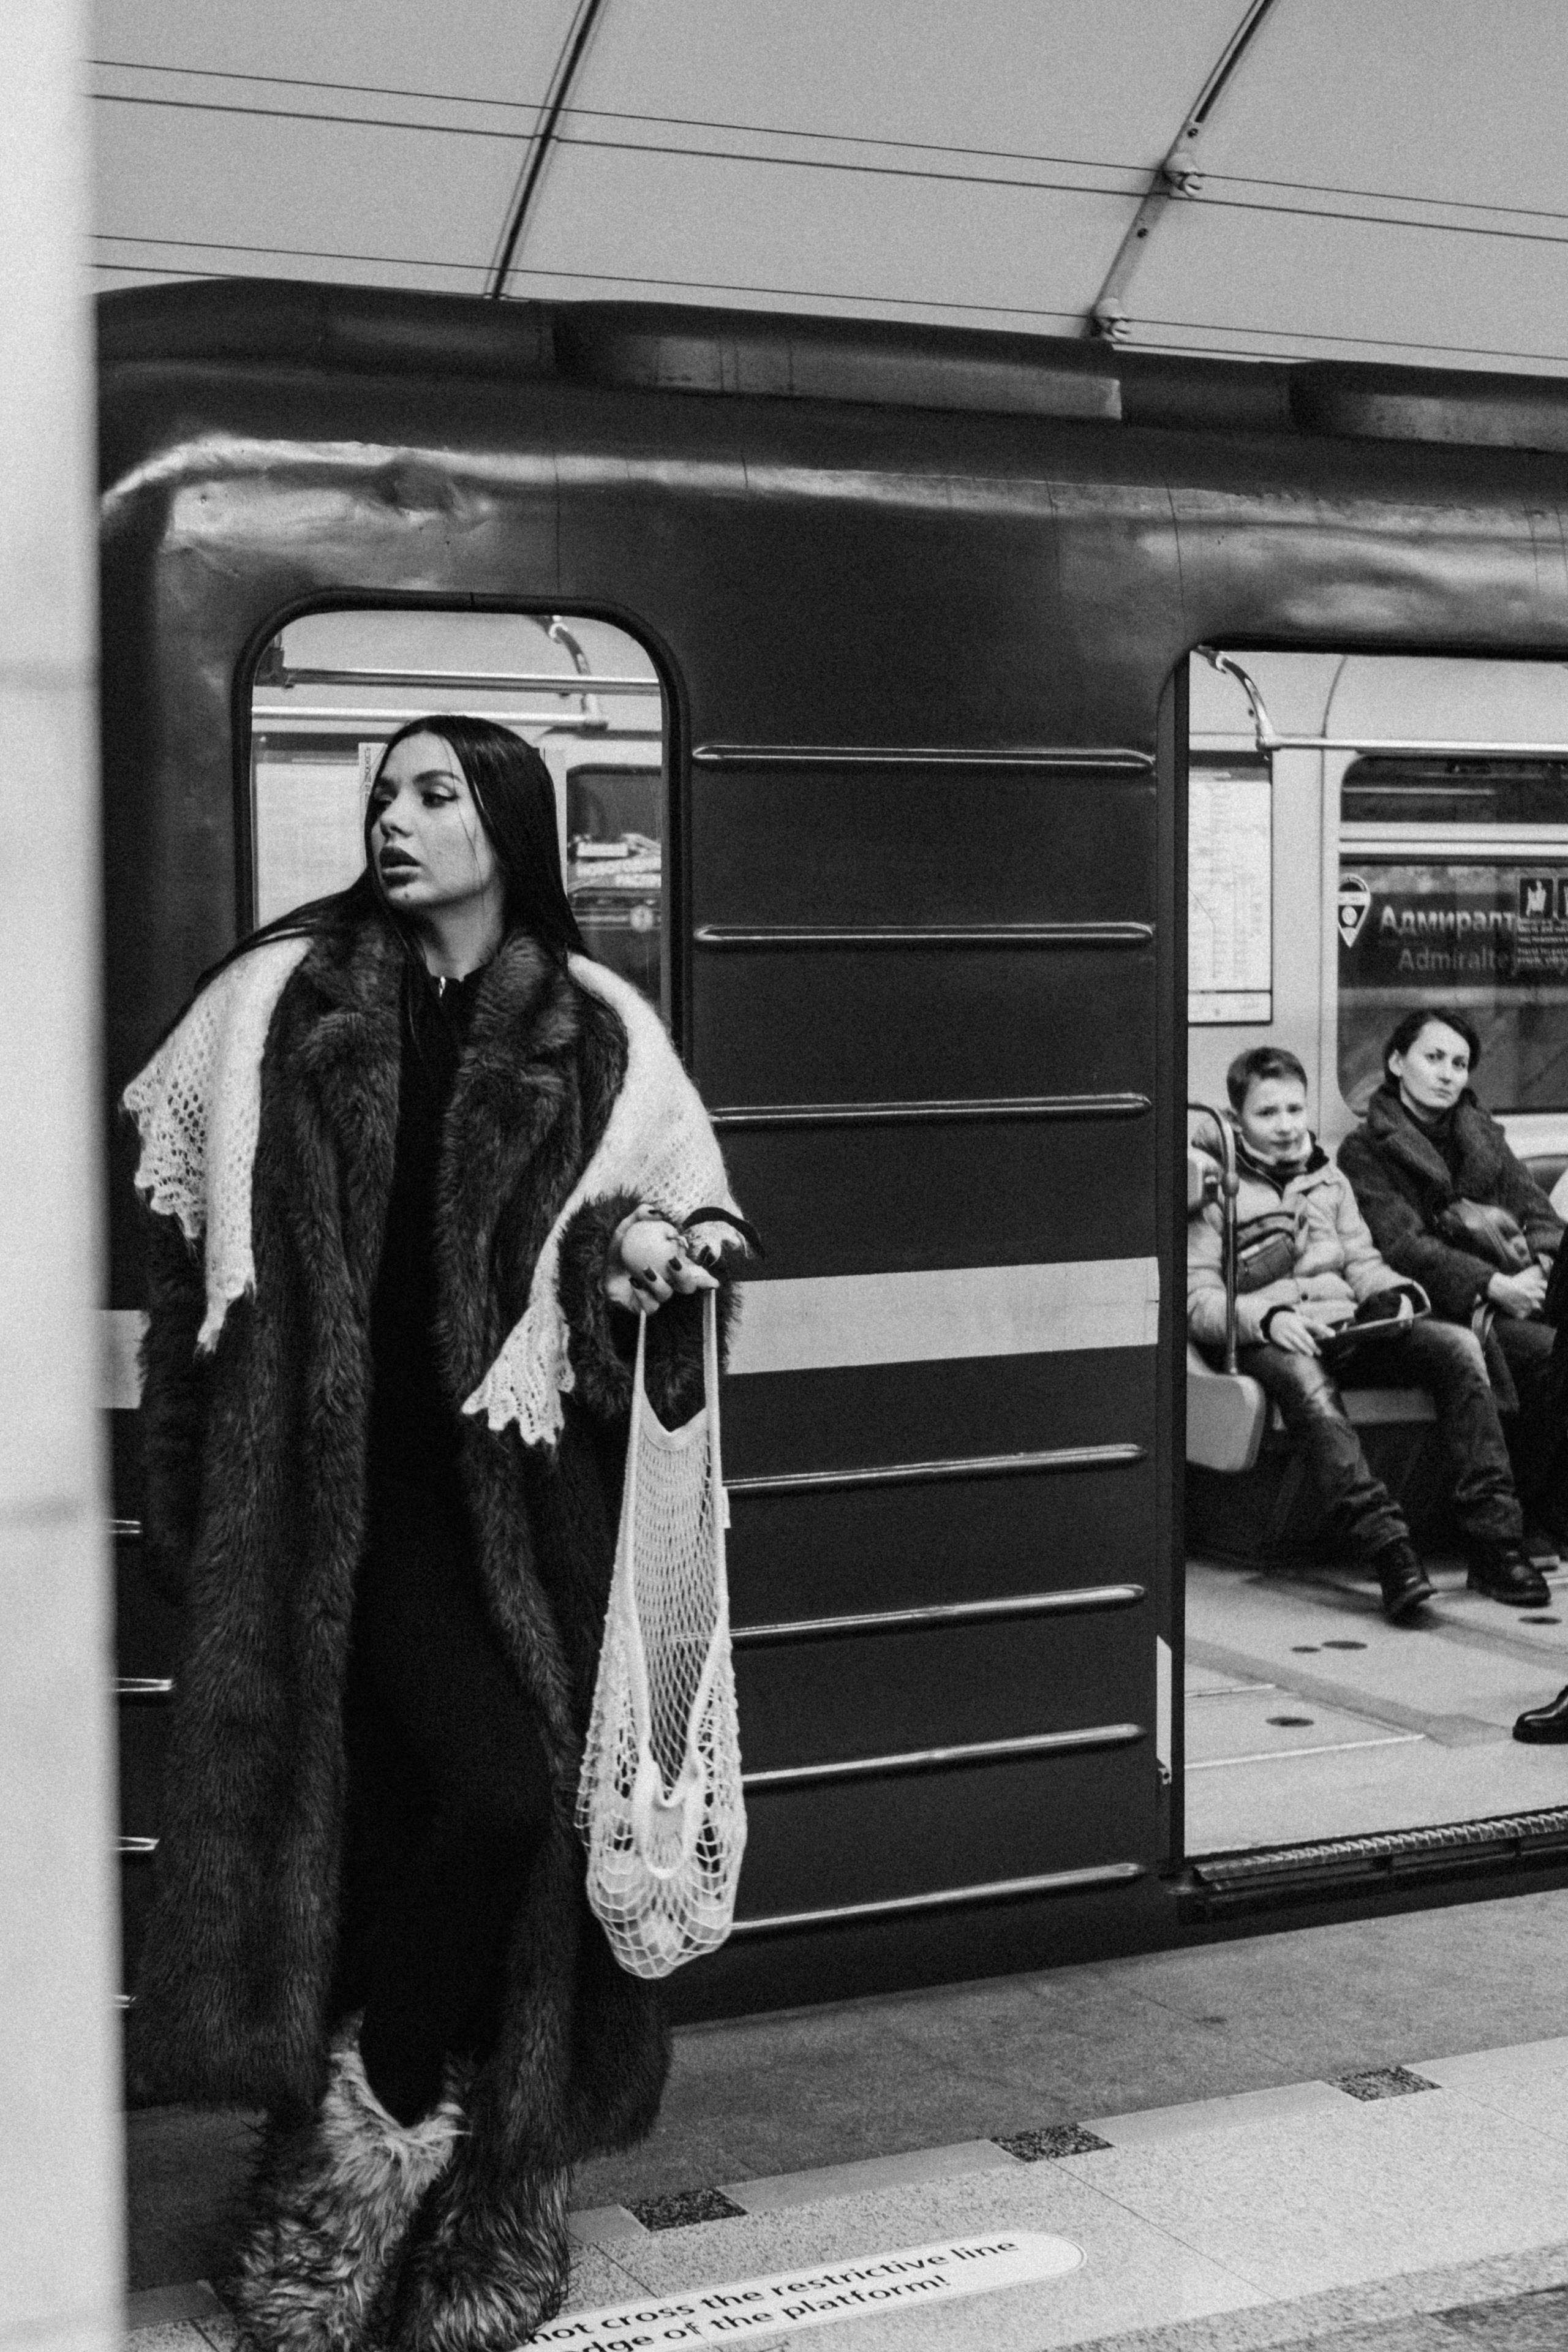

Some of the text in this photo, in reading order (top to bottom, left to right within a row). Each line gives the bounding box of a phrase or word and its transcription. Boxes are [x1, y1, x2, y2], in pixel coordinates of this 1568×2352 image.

[527, 2243, 1019, 2345] not cross the restrictive line
[564, 2275, 951, 2352] dge of the platform!
